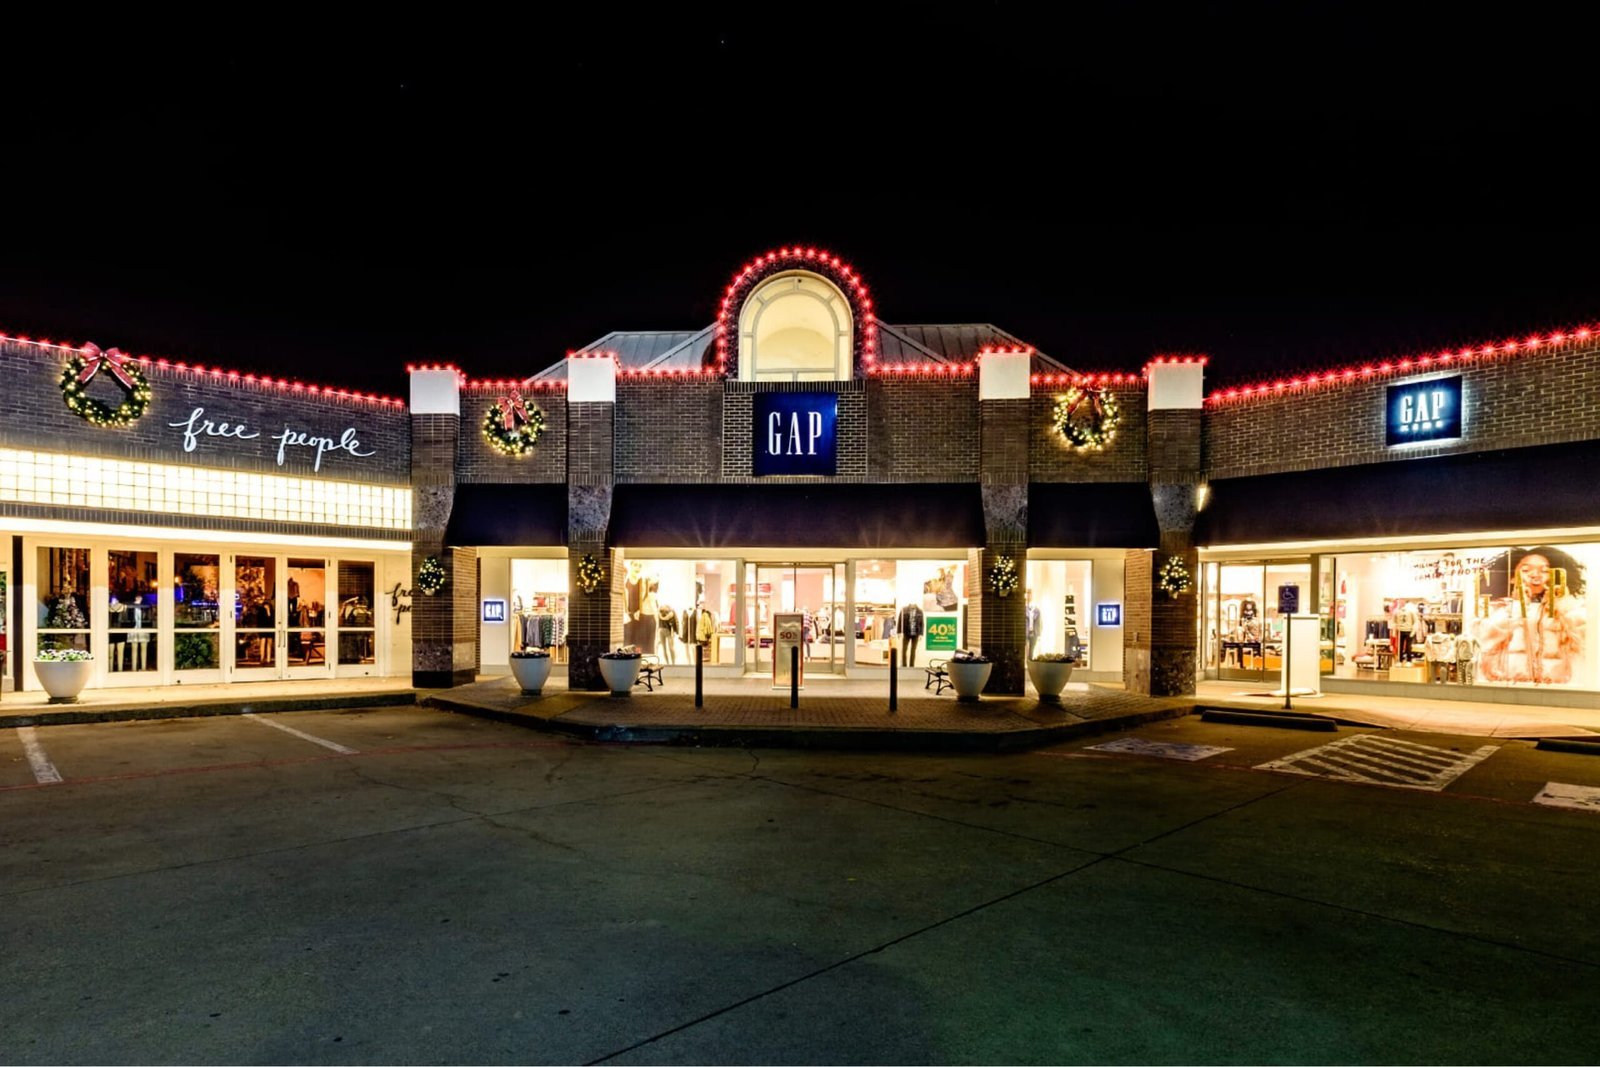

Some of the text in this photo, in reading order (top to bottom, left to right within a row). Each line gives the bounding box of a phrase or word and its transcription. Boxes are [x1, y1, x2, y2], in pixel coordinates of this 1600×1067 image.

[1400, 391, 1445, 423] GAP
[169, 407, 376, 472] free people
[769, 411, 822, 455] GAP
[384, 582, 412, 607] fre
